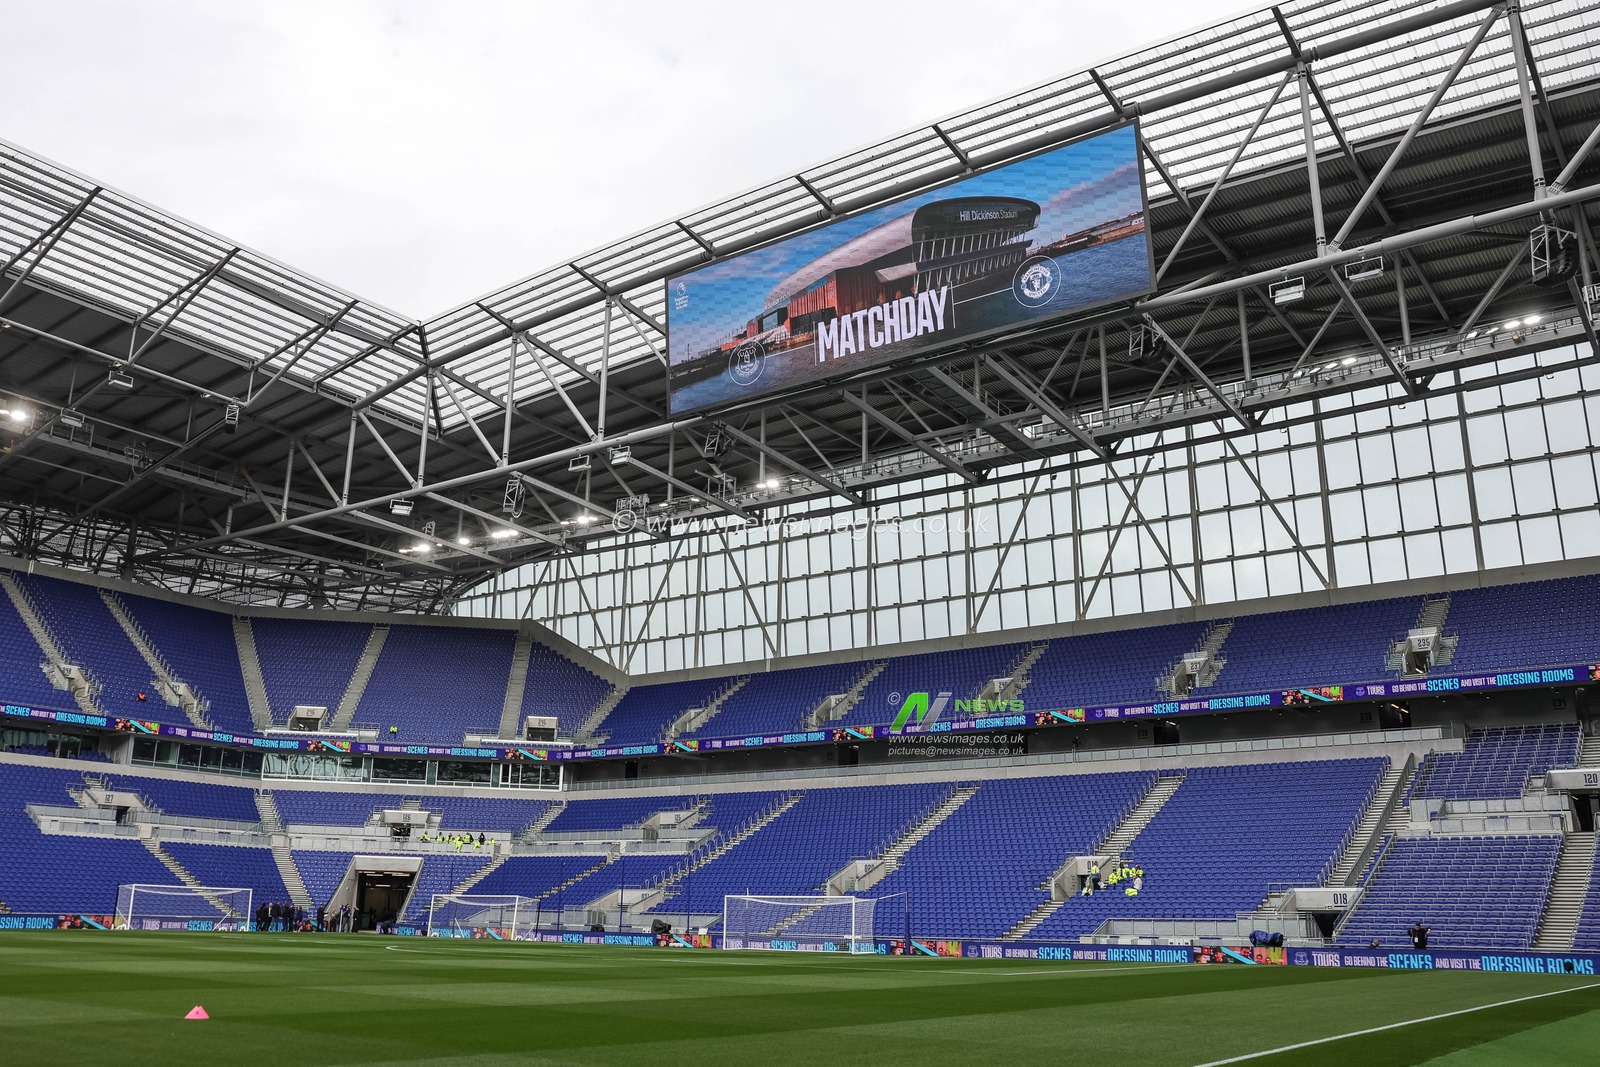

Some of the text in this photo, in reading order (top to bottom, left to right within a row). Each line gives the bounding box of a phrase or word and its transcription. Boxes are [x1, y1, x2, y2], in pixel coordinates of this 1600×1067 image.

[960, 209, 1019, 221] Hill Dickinson Stadium
[817, 286, 947, 363] MATCHDAY
[1417, 638, 1431, 648] 235
[1366, 669, 1574, 695] TOURS GO BEHIND THE SCENES AND VISIT THE DRESSING ROOMS
[1104, 708, 1120, 717] TOURS
[1153, 702, 1179, 714] SCENES
[1201, 701, 1209, 709] THE
[1209, 697, 1244, 710] DRESSING
[1245, 694, 1271, 706] ROOMS
[5, 705, 30, 717] SCENES
[56, 712, 85, 724] DRESSING
[85, 715, 107, 726] ROOMS
[976, 717, 1004, 729] DRESSING
[1004, 715, 1026, 726] ROOMS
[213, 733, 233, 743] SCENES
[253, 738, 279, 749] DRESSING
[279, 739, 299, 749] ROOMS
[745, 737, 763, 746] SCENES
[783, 733, 807, 743] DRESSING
[807, 731, 826, 741] ROOMS
[407, 745, 428, 755] SCENES
[451, 748, 477, 757] DRESSING
[477, 749, 497, 758] ROOMS
[1584, 773, 1598, 784] 120
[1333, 893, 1348, 905] 018
[26, 917, 54, 929] ROOMS
[142, 920, 160, 930] TOURS
[188, 921, 213, 931] SCENES
[398, 926, 415, 936] SCENES
[562, 934, 583, 943] SCENES
[604, 936, 632, 946] DRESSING
[632, 936, 653, 947] ROOMS
[770, 940, 797, 950] SCENES
[980, 946, 1002, 958] TOURS
[1005, 949, 1012, 957] GO
[1013, 949, 1029, 958] BEHIND
[1029, 949, 1038, 959] THE
[1038, 947, 1071, 960] SCENES
[1073, 951, 1083, 960] AND
[1083, 951, 1097, 960] VISIT
[1097, 951, 1107, 961] THE
[1107, 949, 1152, 962] DRESSING
[1154, 950, 1188, 963] ROOMS
[1312, 953, 1340, 967] TOURS
[1344, 956, 1353, 966] GO
[1353, 956, 1376, 967] BEHIND
[1376, 956, 1389, 967] THE
[1389, 954, 1433, 969] SCENES
[1435, 957, 1450, 969] AND
[1450, 958, 1467, 969] VISIT
[1467, 958, 1482, 970] THE
[1481, 955, 1544, 973] DRESSING
